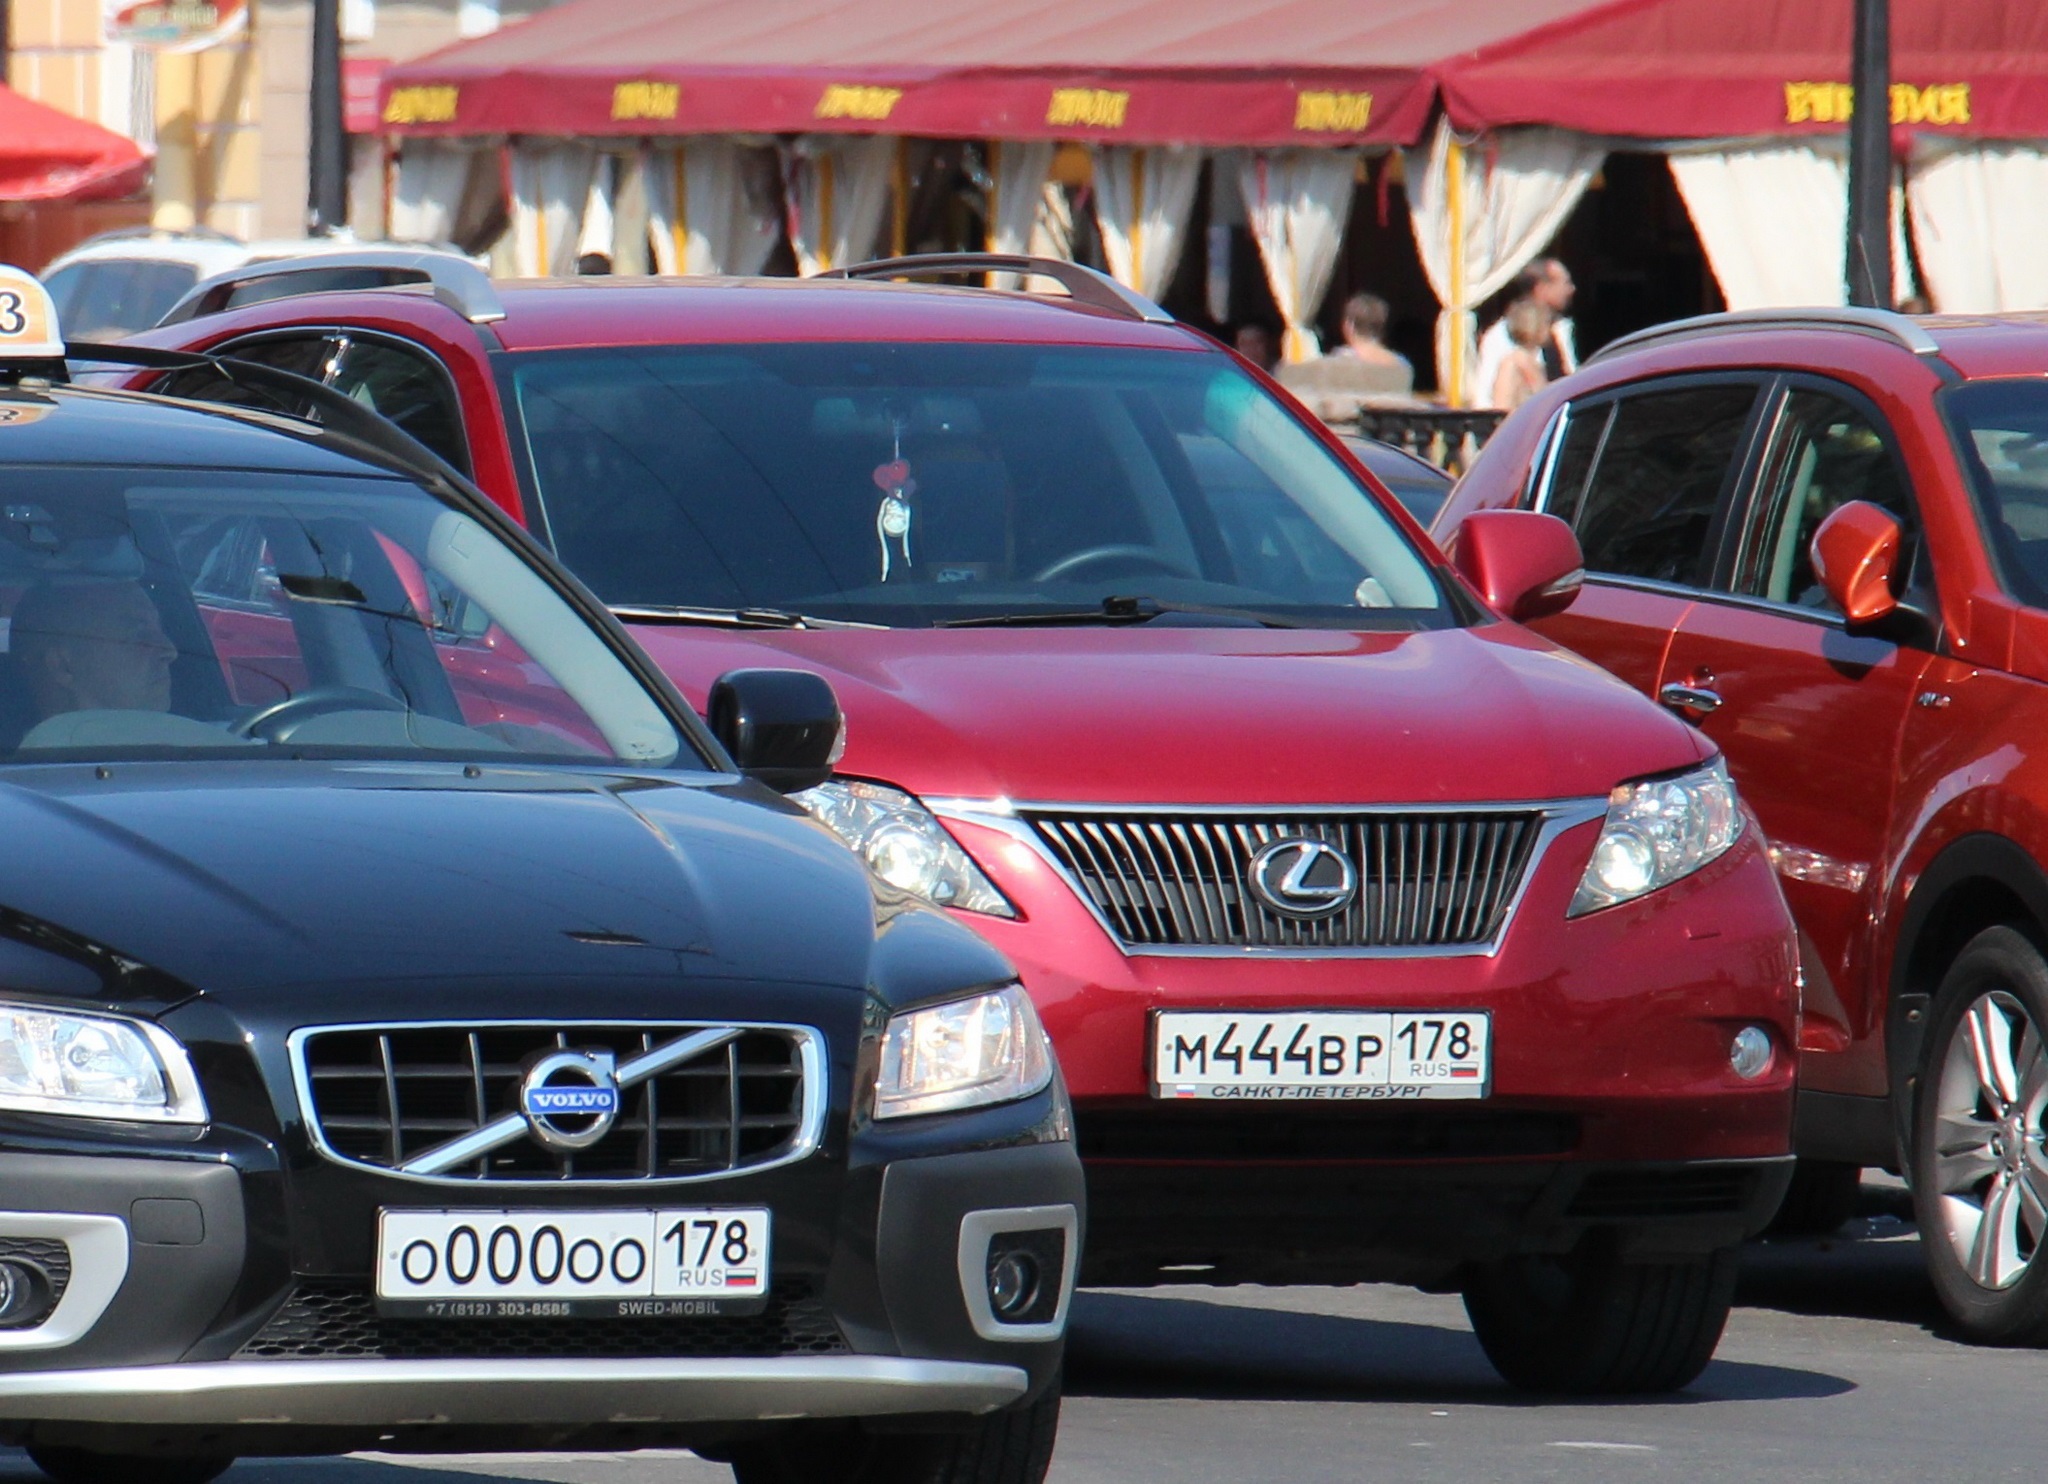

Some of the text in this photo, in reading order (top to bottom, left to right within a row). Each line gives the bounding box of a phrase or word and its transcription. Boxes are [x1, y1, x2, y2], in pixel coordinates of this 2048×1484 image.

[1397, 1020, 1471, 1061] 178
[1410, 1063, 1448, 1077] RUS
[1211, 1084, 1432, 1099] САНКТ-ПЕТЕРБУРГ
[533, 1093, 612, 1107] VOLVO
[663, 1219, 748, 1267] 178
[679, 1269, 722, 1286] RUS
[450, 1303, 491, 1316] (812)
[497, 1302, 570, 1316] 303-8585
